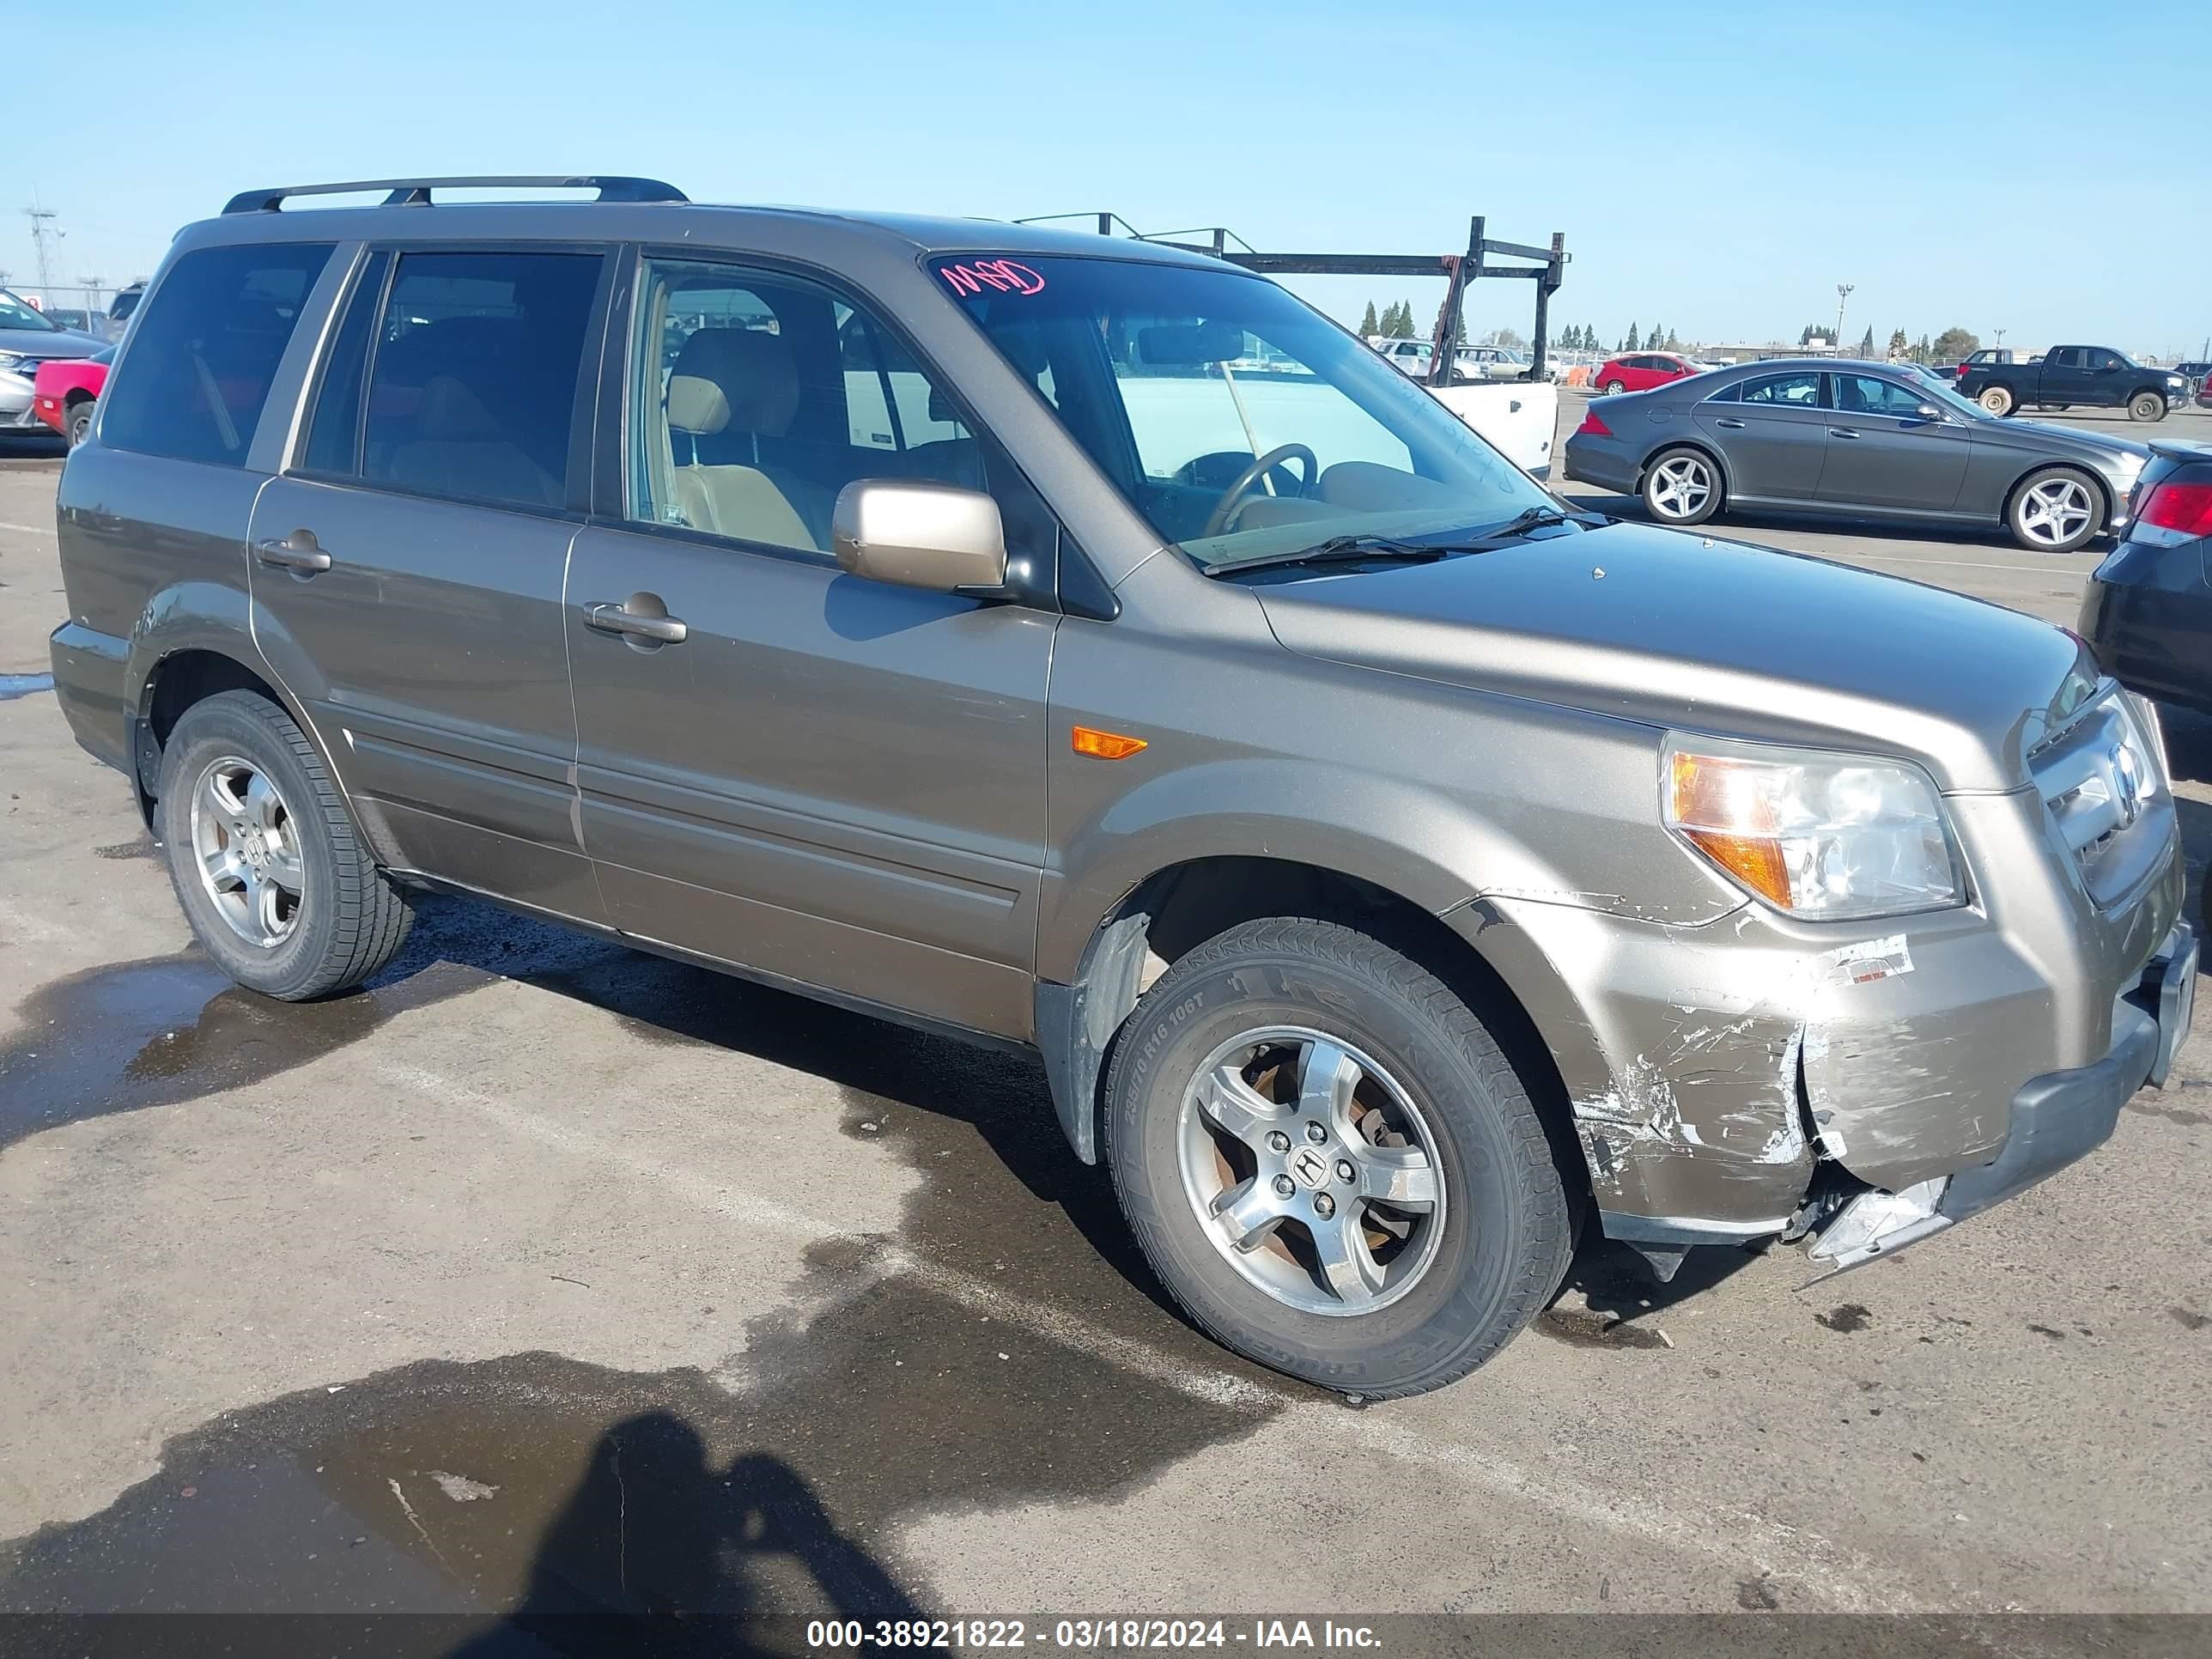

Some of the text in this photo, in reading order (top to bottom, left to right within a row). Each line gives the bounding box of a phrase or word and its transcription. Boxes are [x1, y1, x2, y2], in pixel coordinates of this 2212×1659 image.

[1124, 992, 1205, 1125] 235/70 R16 106T
